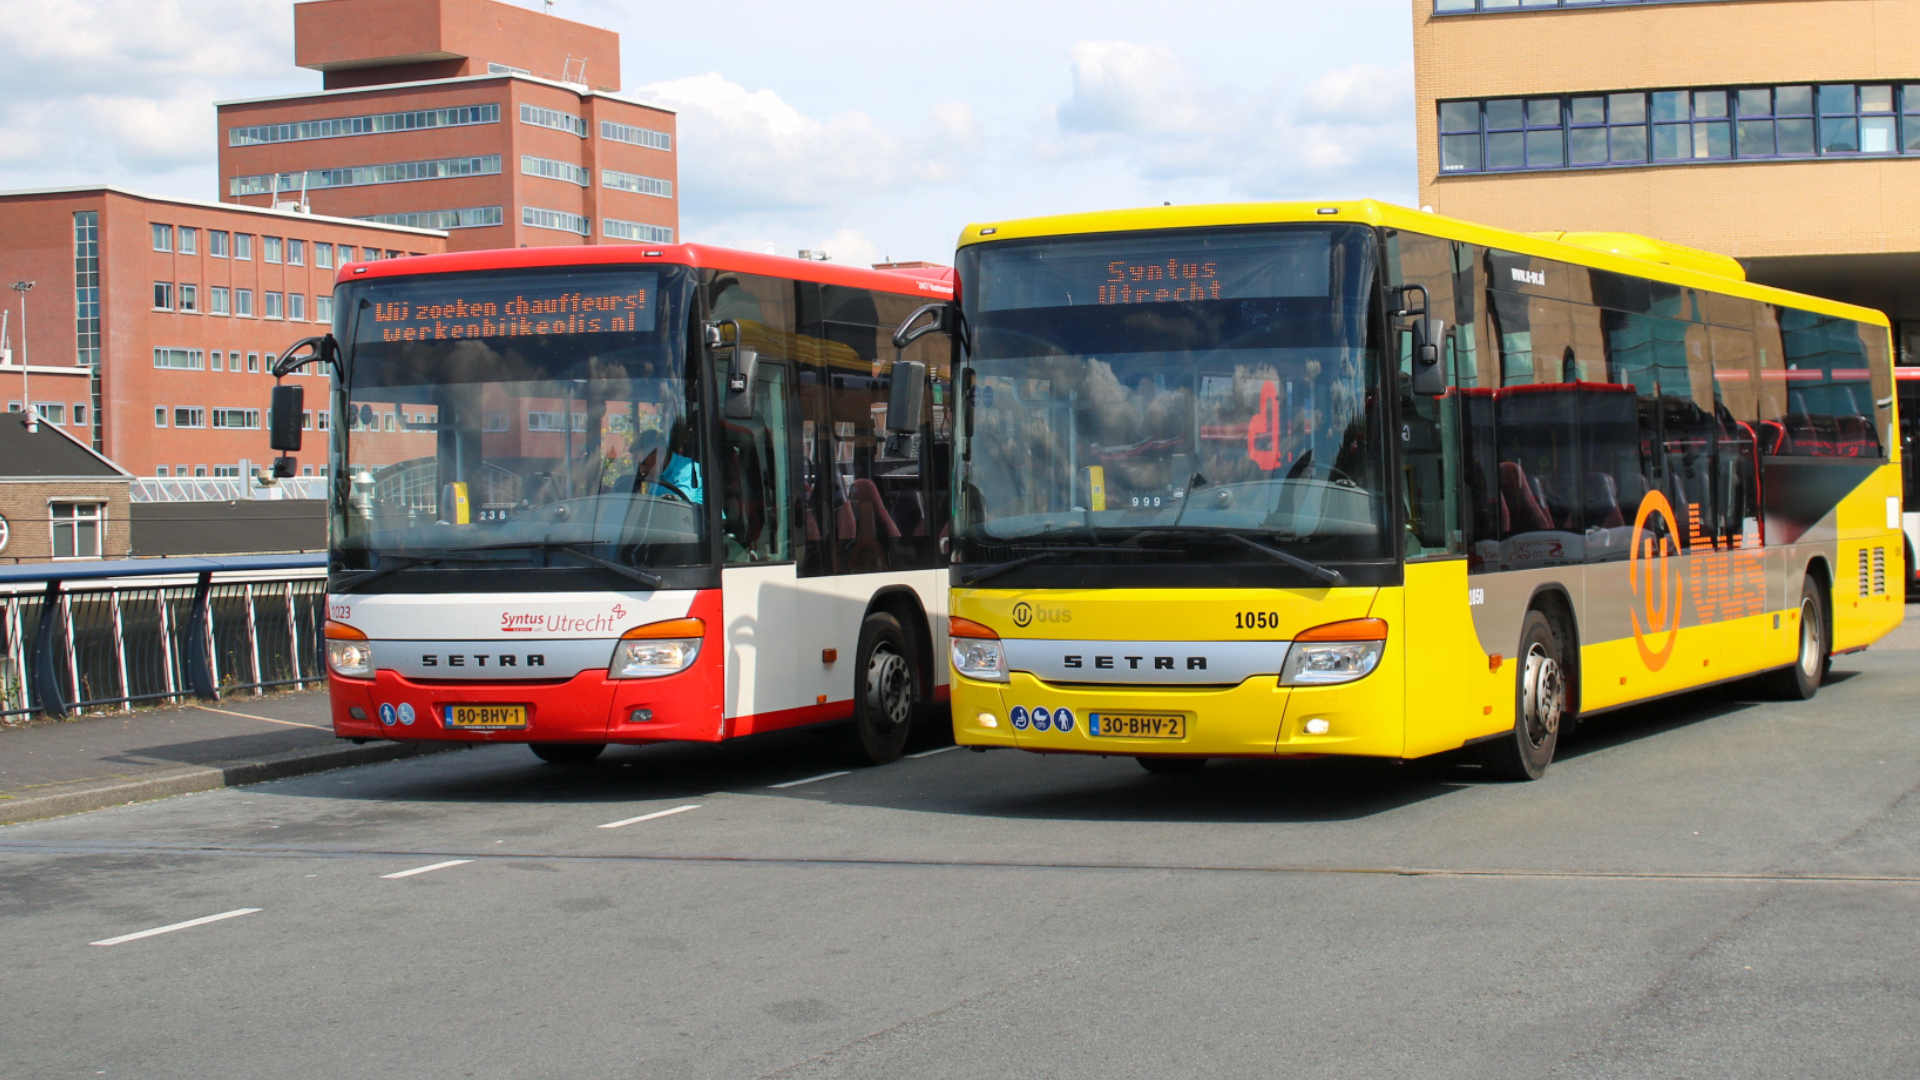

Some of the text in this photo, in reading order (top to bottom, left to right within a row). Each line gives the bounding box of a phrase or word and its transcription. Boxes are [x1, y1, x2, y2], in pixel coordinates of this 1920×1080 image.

[1107, 259, 1217, 282] Syntus
[1099, 280, 1221, 304] Utrecht
[375, 289, 645, 321] Wij zoeken chauffeurs!
[383, 311, 635, 342] werkenbijkeolis.nl
[1132, 496, 1160, 507] 999
[480, 510, 506, 520] 236
[331, 605, 351, 619] 1023
[1036, 603, 1073, 624] bus
[1235, 611, 1279, 629] 1050
[501, 611, 614, 632] Syntus Utrecht
[422, 654, 545, 667] SETRA
[1064, 655, 1207, 670] SETRA
[457, 708, 519, 723] 80-BHV-1
[1102, 717, 1178, 735] 30-BHV-2
